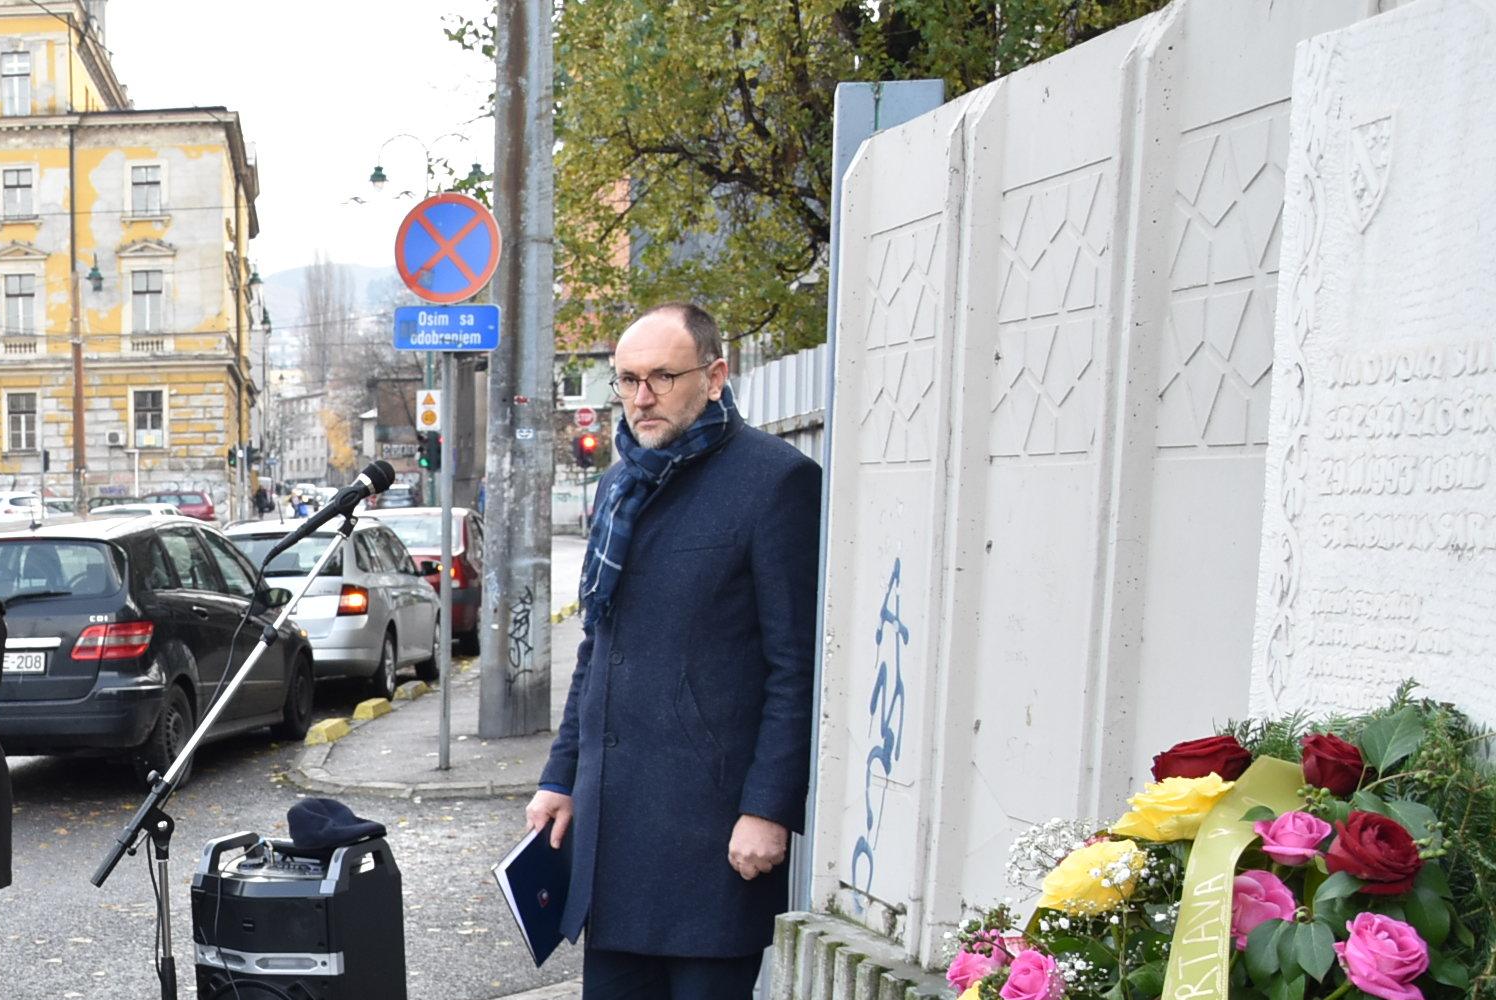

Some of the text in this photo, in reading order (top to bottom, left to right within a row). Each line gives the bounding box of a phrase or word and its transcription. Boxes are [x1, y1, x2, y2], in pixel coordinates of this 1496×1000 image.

[418, 311, 475, 327] Osim sa
[410, 330, 482, 348] odobrenjem
